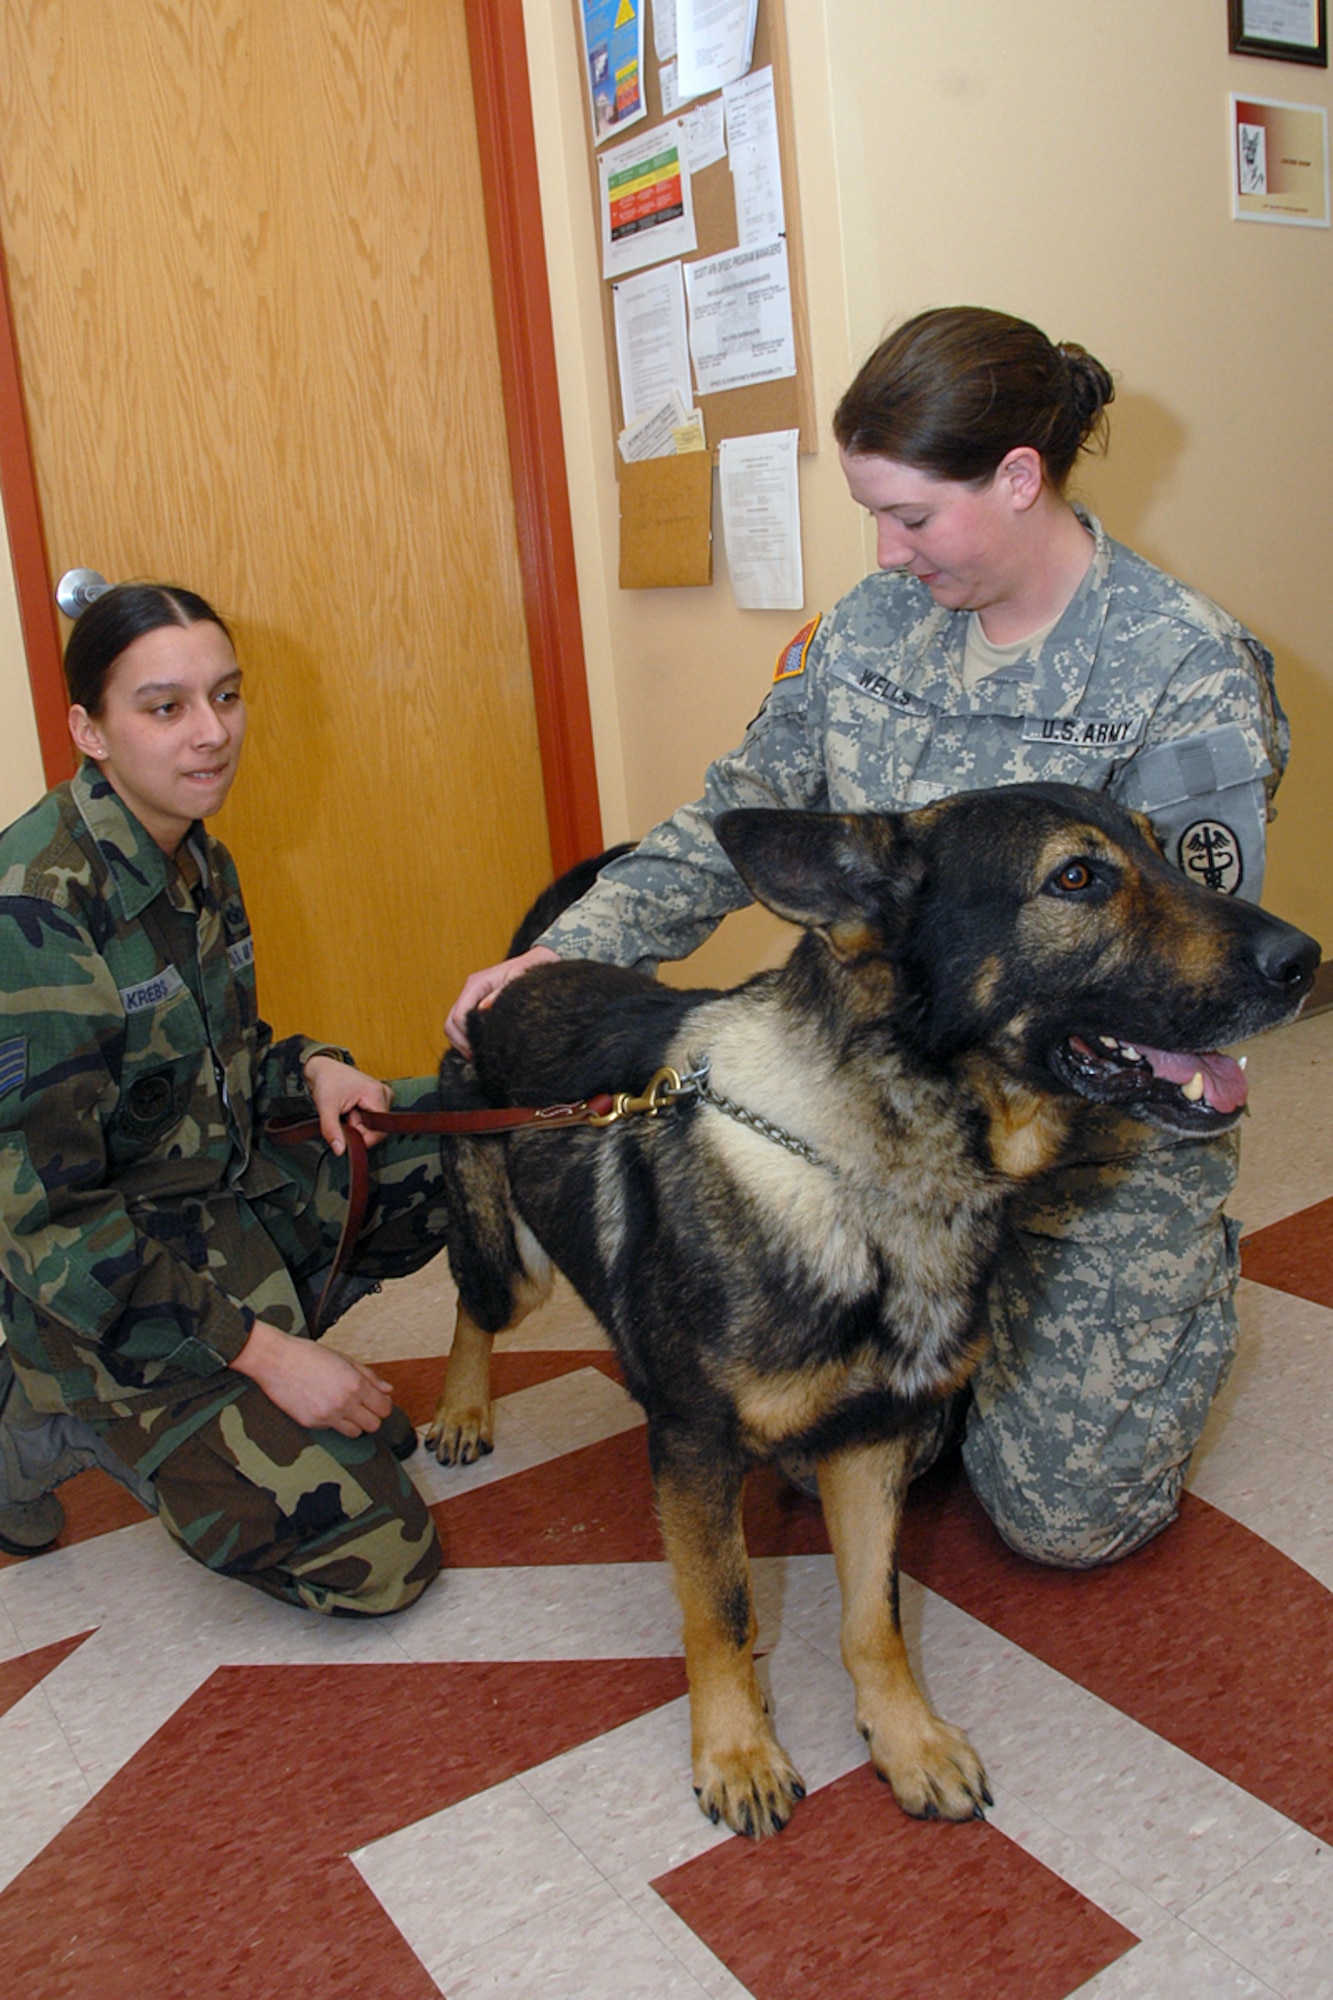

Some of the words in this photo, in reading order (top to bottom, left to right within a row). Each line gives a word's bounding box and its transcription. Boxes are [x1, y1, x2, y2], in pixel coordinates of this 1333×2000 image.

[859, 668, 910, 705] WELLS
[1042, 719, 1079, 742] U.S.
[1083, 721, 1132, 743] ARMY
[126, 980, 168, 1009] KREBS
